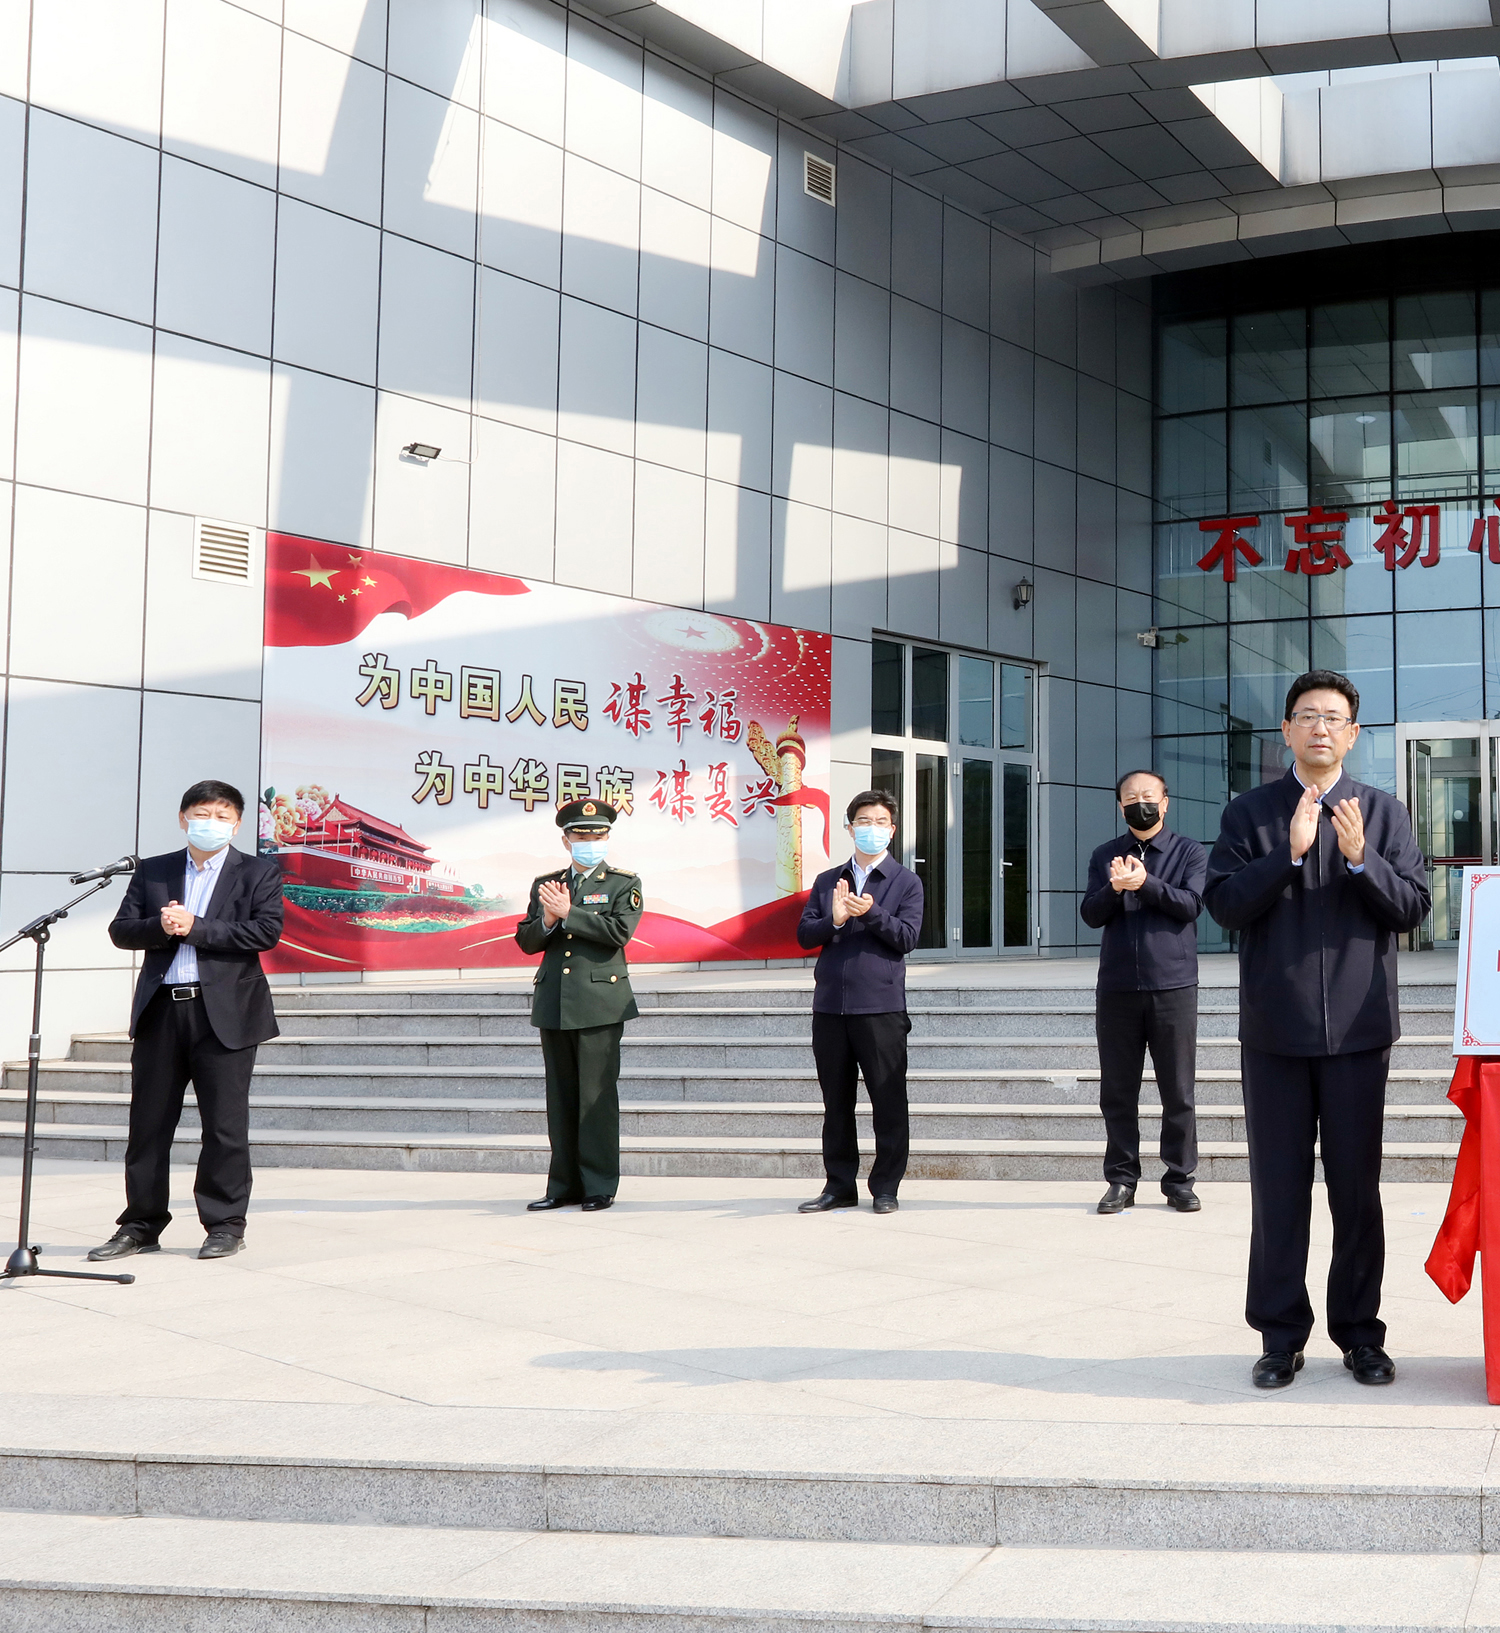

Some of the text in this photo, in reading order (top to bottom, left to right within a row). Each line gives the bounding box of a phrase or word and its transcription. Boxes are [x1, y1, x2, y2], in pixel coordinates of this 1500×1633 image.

[355, 652, 743, 745] 为中国人民 谋幸福
[411, 750, 778, 829] 为中华民族 谋复兴
